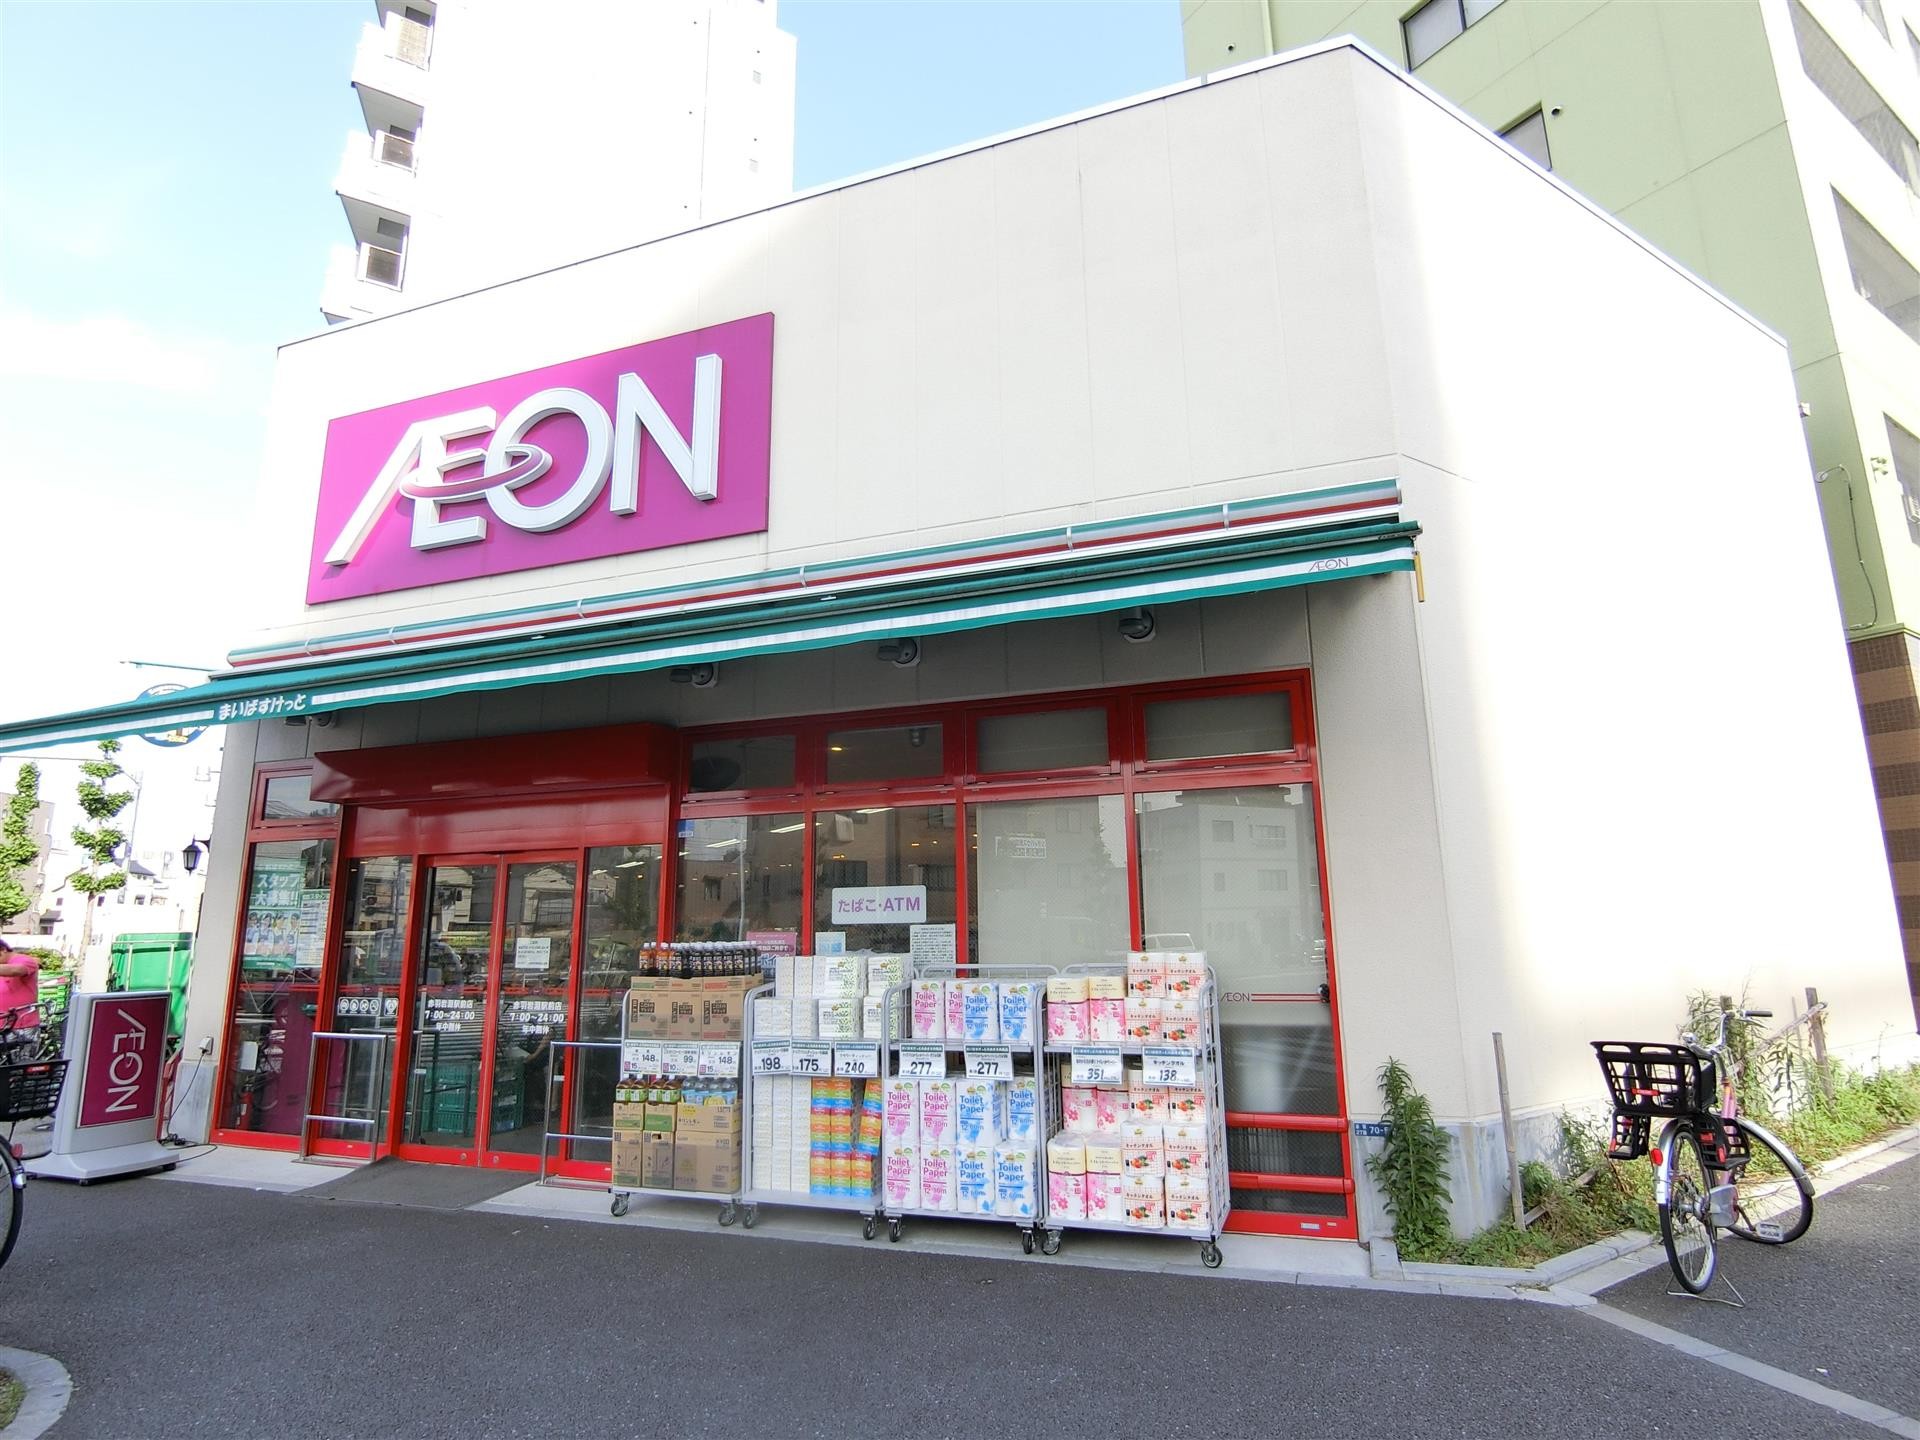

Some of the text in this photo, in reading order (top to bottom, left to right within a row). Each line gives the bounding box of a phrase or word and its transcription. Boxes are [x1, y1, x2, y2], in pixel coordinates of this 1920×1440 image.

[219, 693, 306, 720] まいばすけっと
[915, 992, 936, 1000] Toilet
[965, 996, 987, 1004] Toilet
[1003, 996, 1025, 1004] Toilet
[915, 1000, 936, 1008] Paper
[966, 1003, 988, 1012] Paper
[1003, 1004, 1027, 1012] Paper
[642, 1054, 656, 1062] 148
[718, 1056, 732, 1064] 148
[761, 1056, 781, 1070] 198
[799, 1058, 819, 1072] 175
[844, 1062, 865, 1073] 240
[910, 1062, 932, 1074] 277
[977, 1062, 999, 1074] 277
[1087, 1068, 1104, 1080] 351
[1160, 1070, 1177, 1081] 138
[888, 1092, 910, 1100] Toilet
[924, 1092, 947, 1101] Toilet
[1010, 1090, 1033, 1099] Toilet
[960, 1096, 983, 1104] Toilet
[1010, 1099, 1034, 1108] Paper
[888, 1101, 911, 1110] Paper
[924, 1102, 948, 1110] Paper
[960, 1104, 984, 1112] Paper
[888, 1157, 910, 1166] Toilet
[924, 1159, 946, 1168] Toilet
[960, 1161, 984, 1170] Toilet
[888, 1166, 910, 1175] Paper
[924, 1168, 948, 1176] Paper
[998, 1163, 1022, 1172] Toilet
[960, 1171, 985, 1179] Paper
[998, 1172, 1024, 1181] Paper
